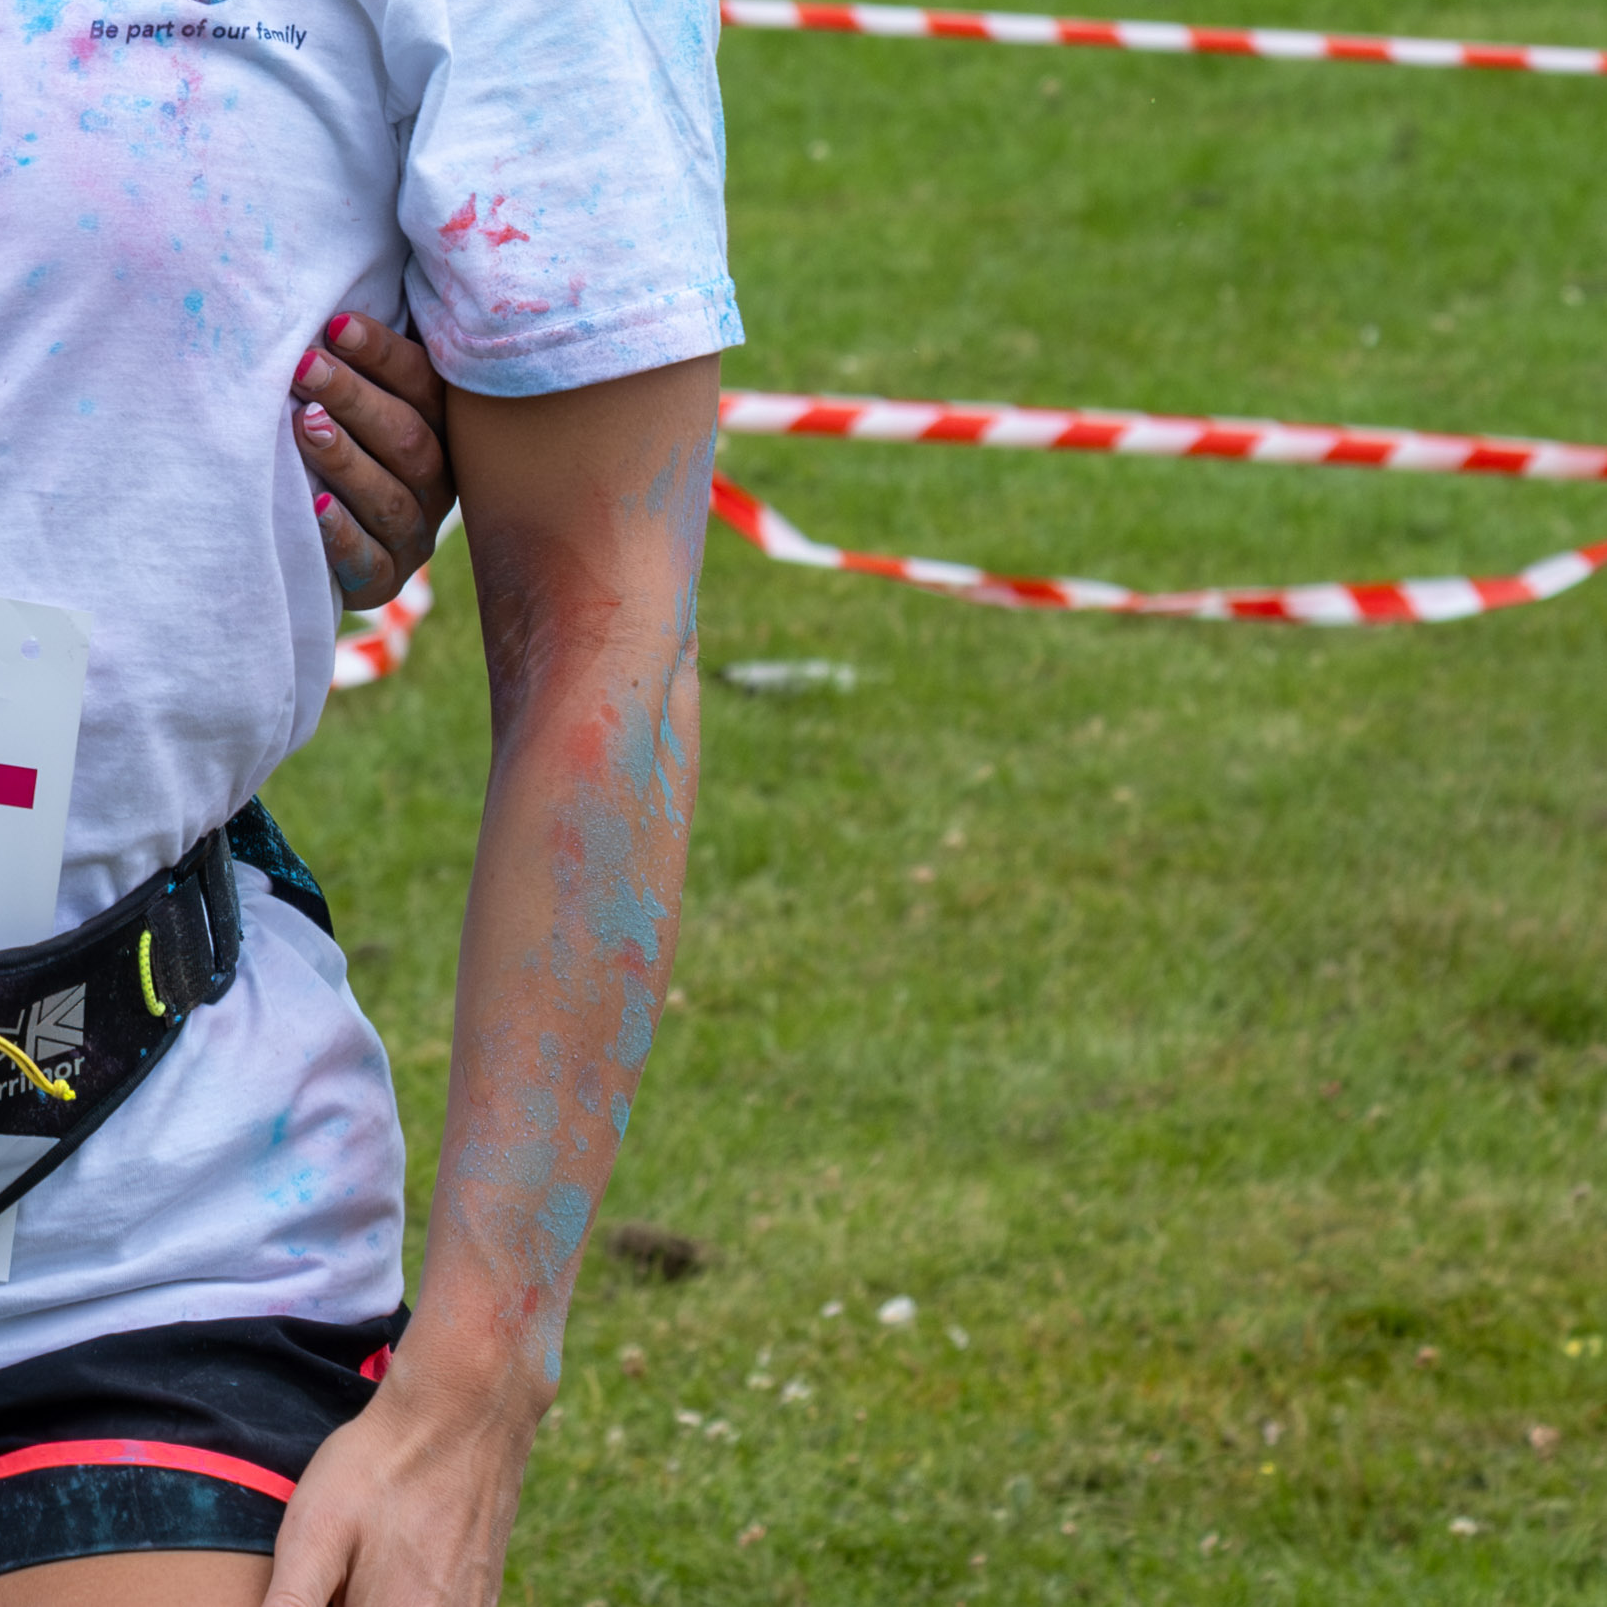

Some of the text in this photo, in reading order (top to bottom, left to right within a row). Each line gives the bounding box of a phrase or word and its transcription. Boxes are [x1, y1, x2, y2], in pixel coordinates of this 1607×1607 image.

[90, 19, 307, 50] Be part of our family
